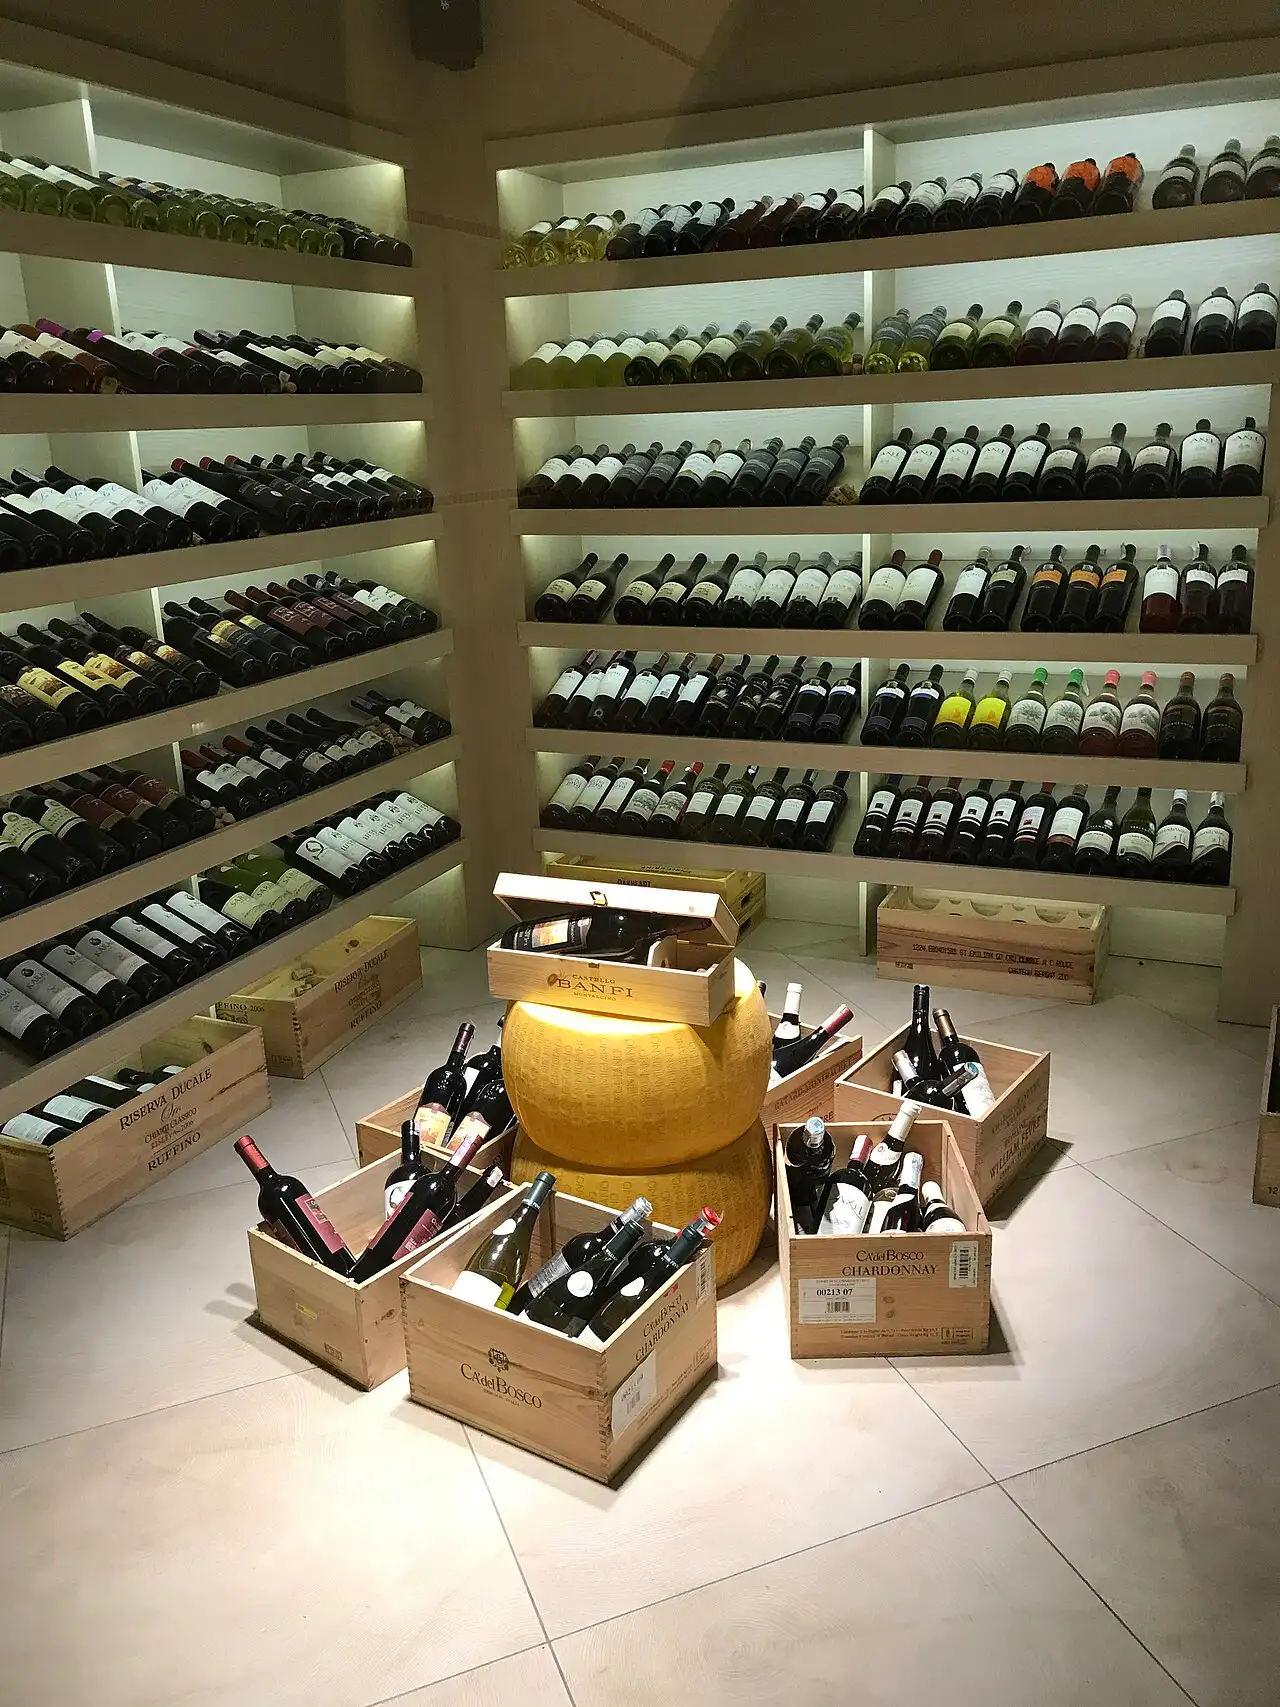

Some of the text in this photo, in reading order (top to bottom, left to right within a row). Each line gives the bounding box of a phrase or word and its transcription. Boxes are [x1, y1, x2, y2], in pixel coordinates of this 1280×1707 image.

[572, 974, 616, 984] CASTELLO
[557, 978, 633, 998] BANFI
[119, 1068, 212, 1131] RISERVA DUCALE
[147, 1131, 201, 1172] RUFFINO
[842, 1264, 938, 1277] CHARDONNAY
[816, 1288, 853, 1296] 00213 07
